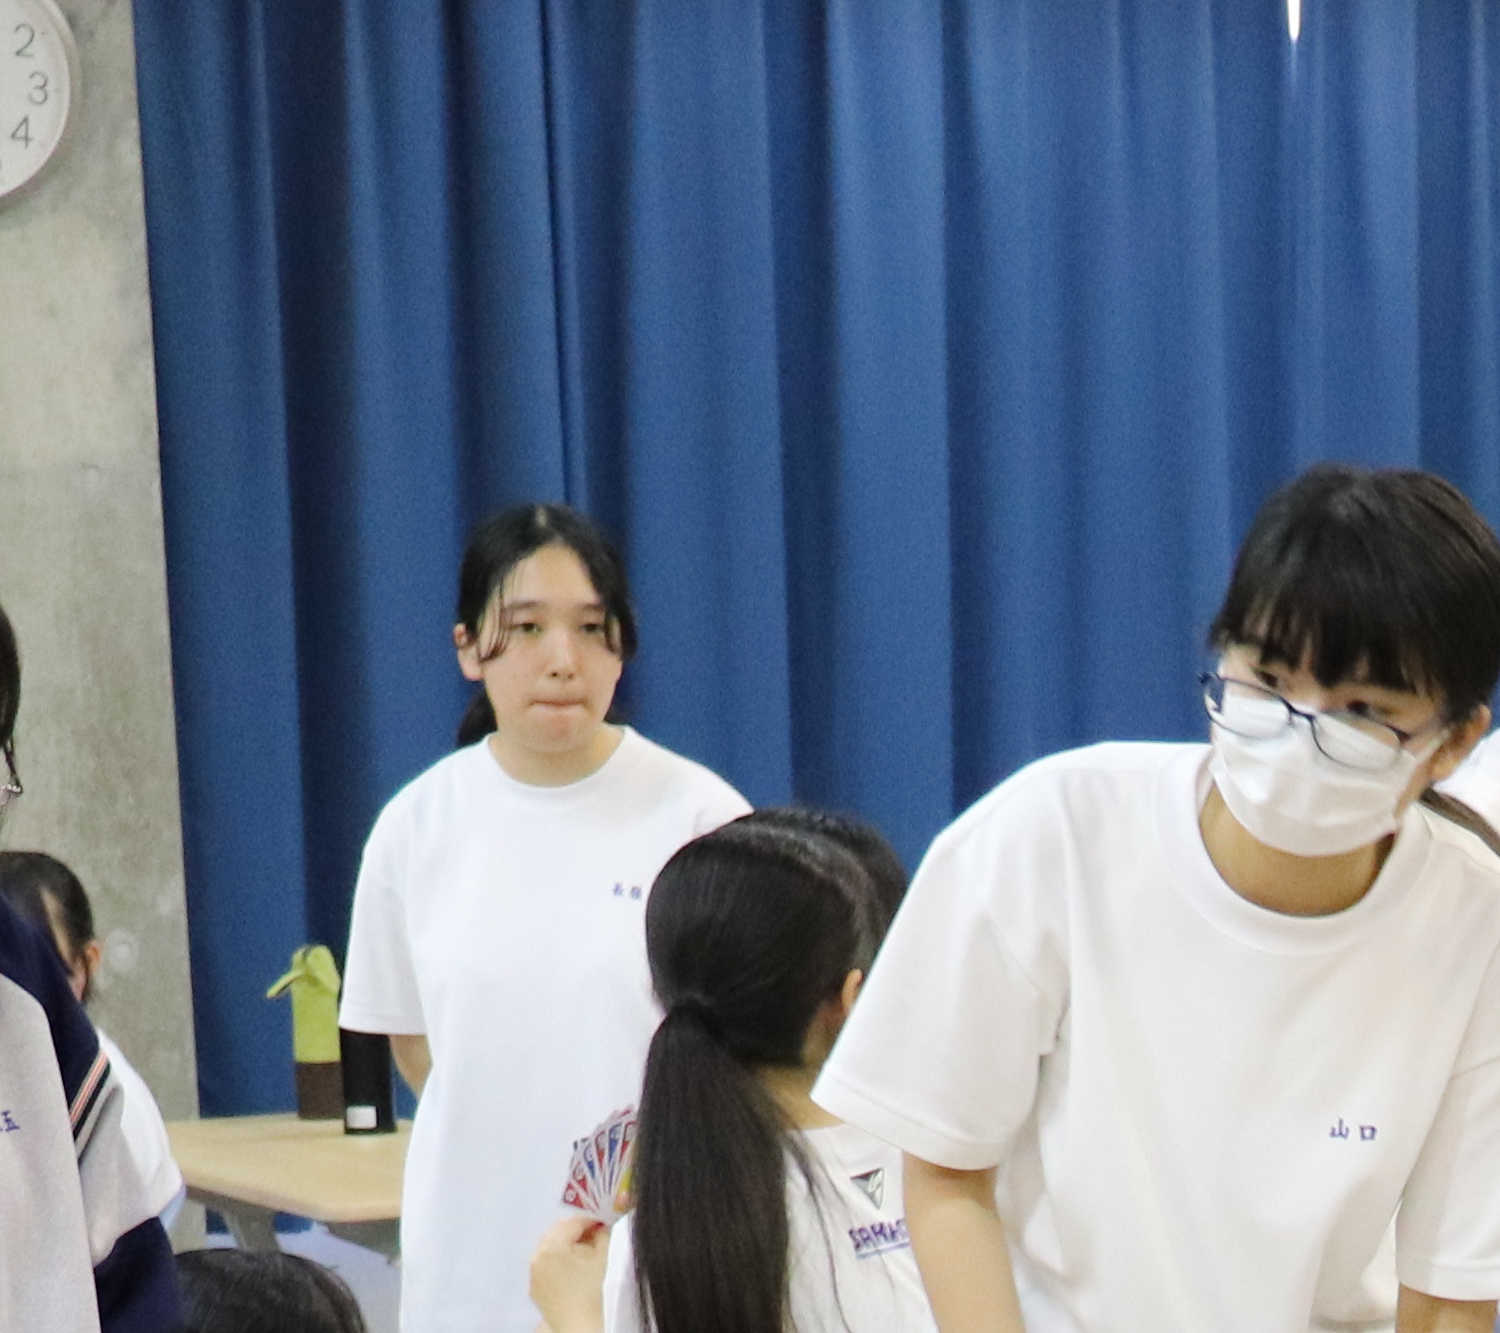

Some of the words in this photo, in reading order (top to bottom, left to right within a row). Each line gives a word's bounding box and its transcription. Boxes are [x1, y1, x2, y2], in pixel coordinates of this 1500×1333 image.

[13, 23, 35, 58] 2
[28, 71, 48, 105] 3
[11, 115, 33, 149] 4
[1329, 1117, 1378, 1141] 山口
